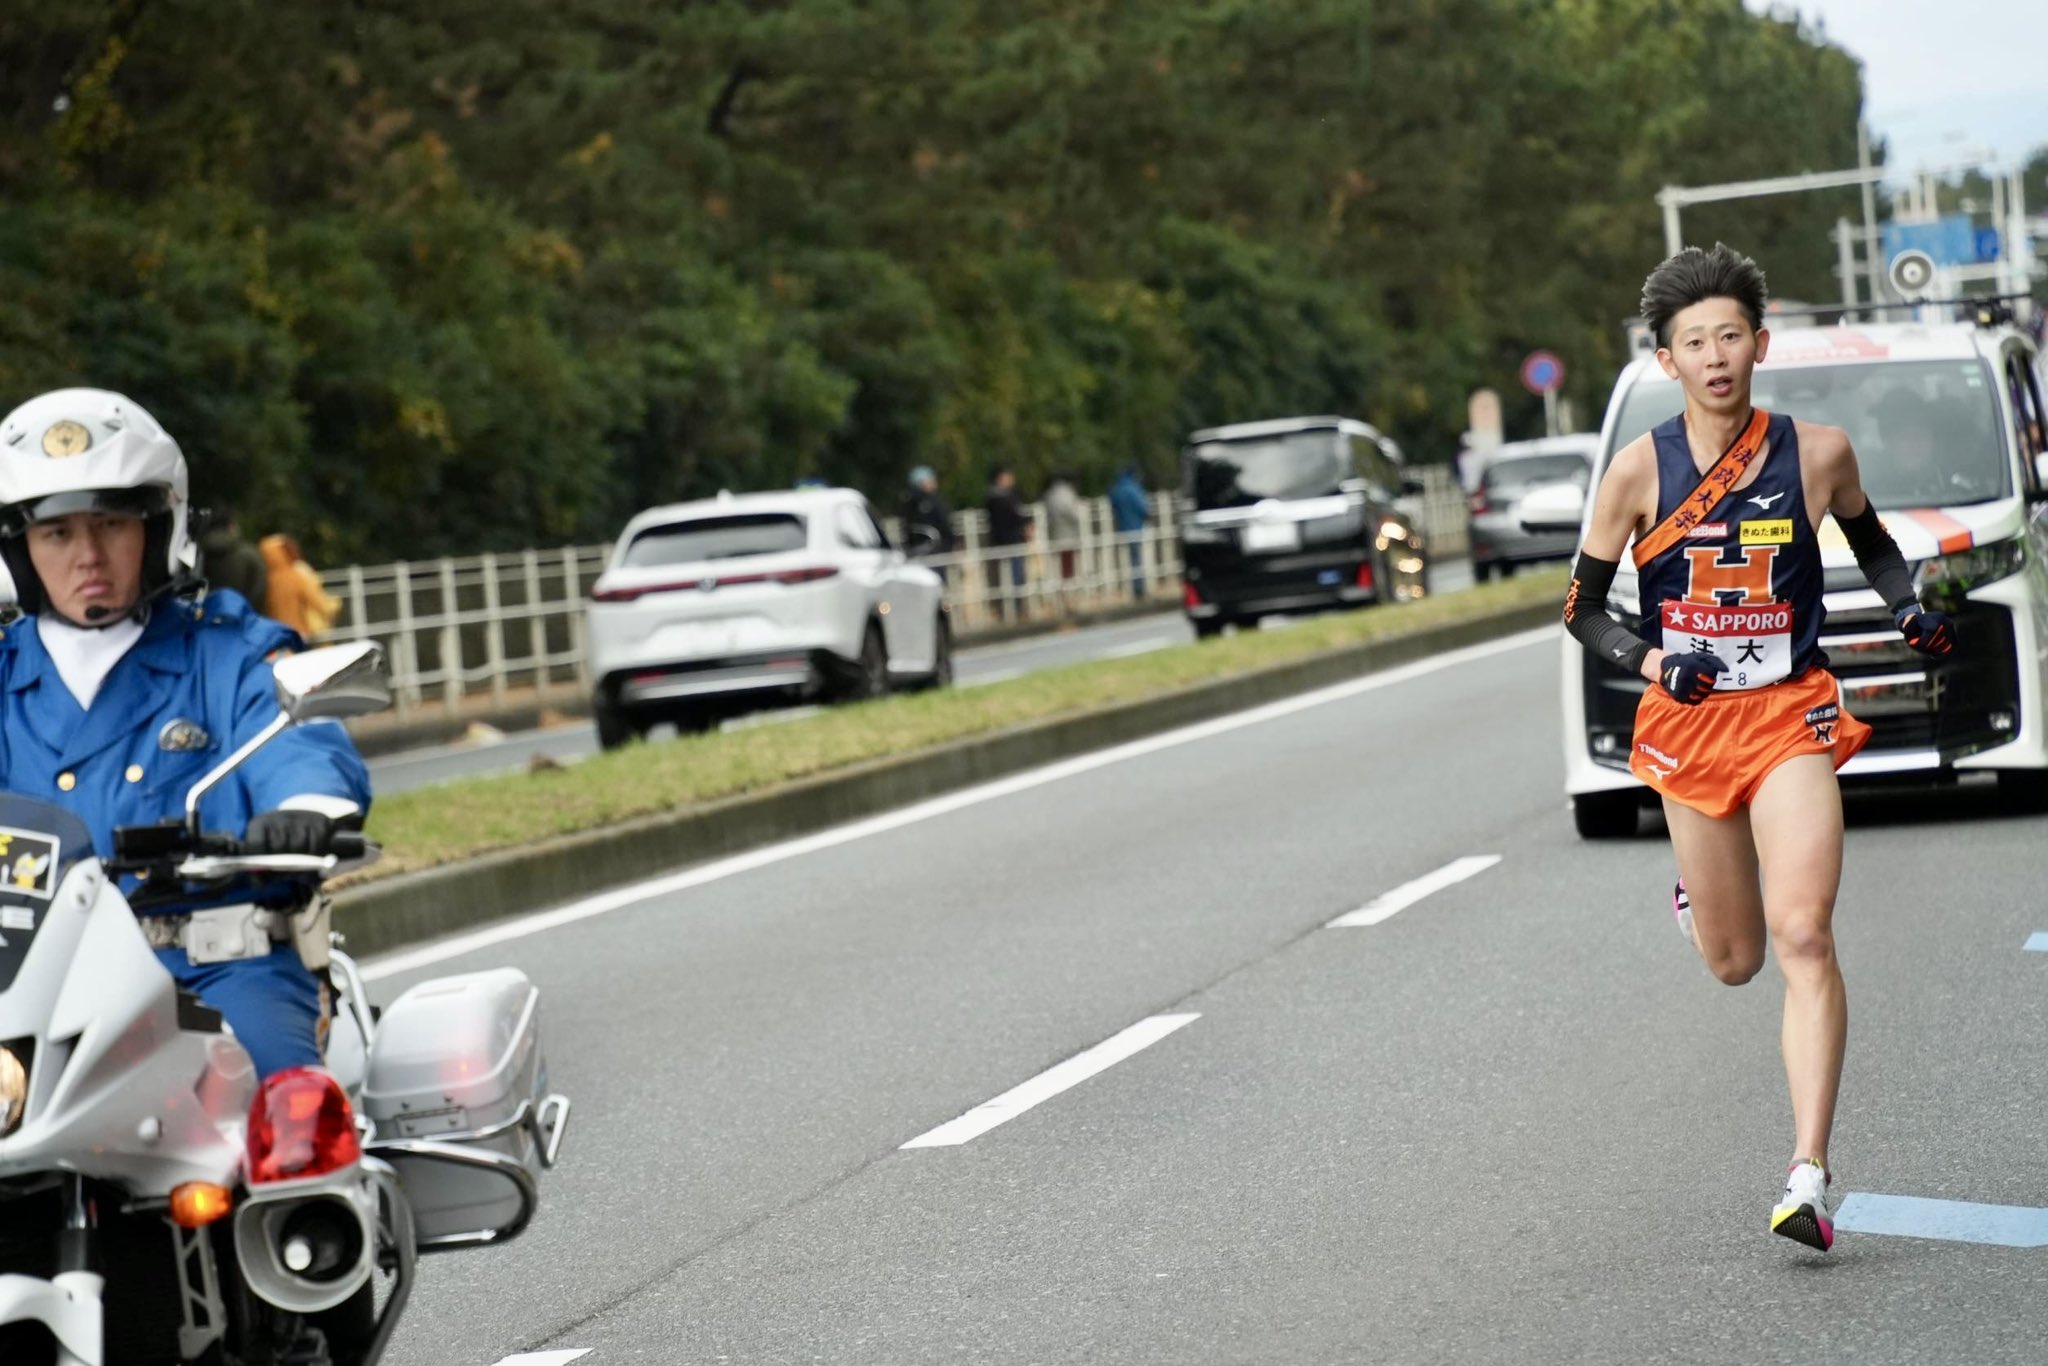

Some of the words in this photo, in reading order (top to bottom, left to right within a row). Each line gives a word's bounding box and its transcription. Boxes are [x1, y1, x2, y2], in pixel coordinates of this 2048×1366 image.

[1742, 526, 1791, 538] きぬた歯科
[1682, 544, 1780, 608] H
[1692, 610, 1789, 632] SAPPORO
